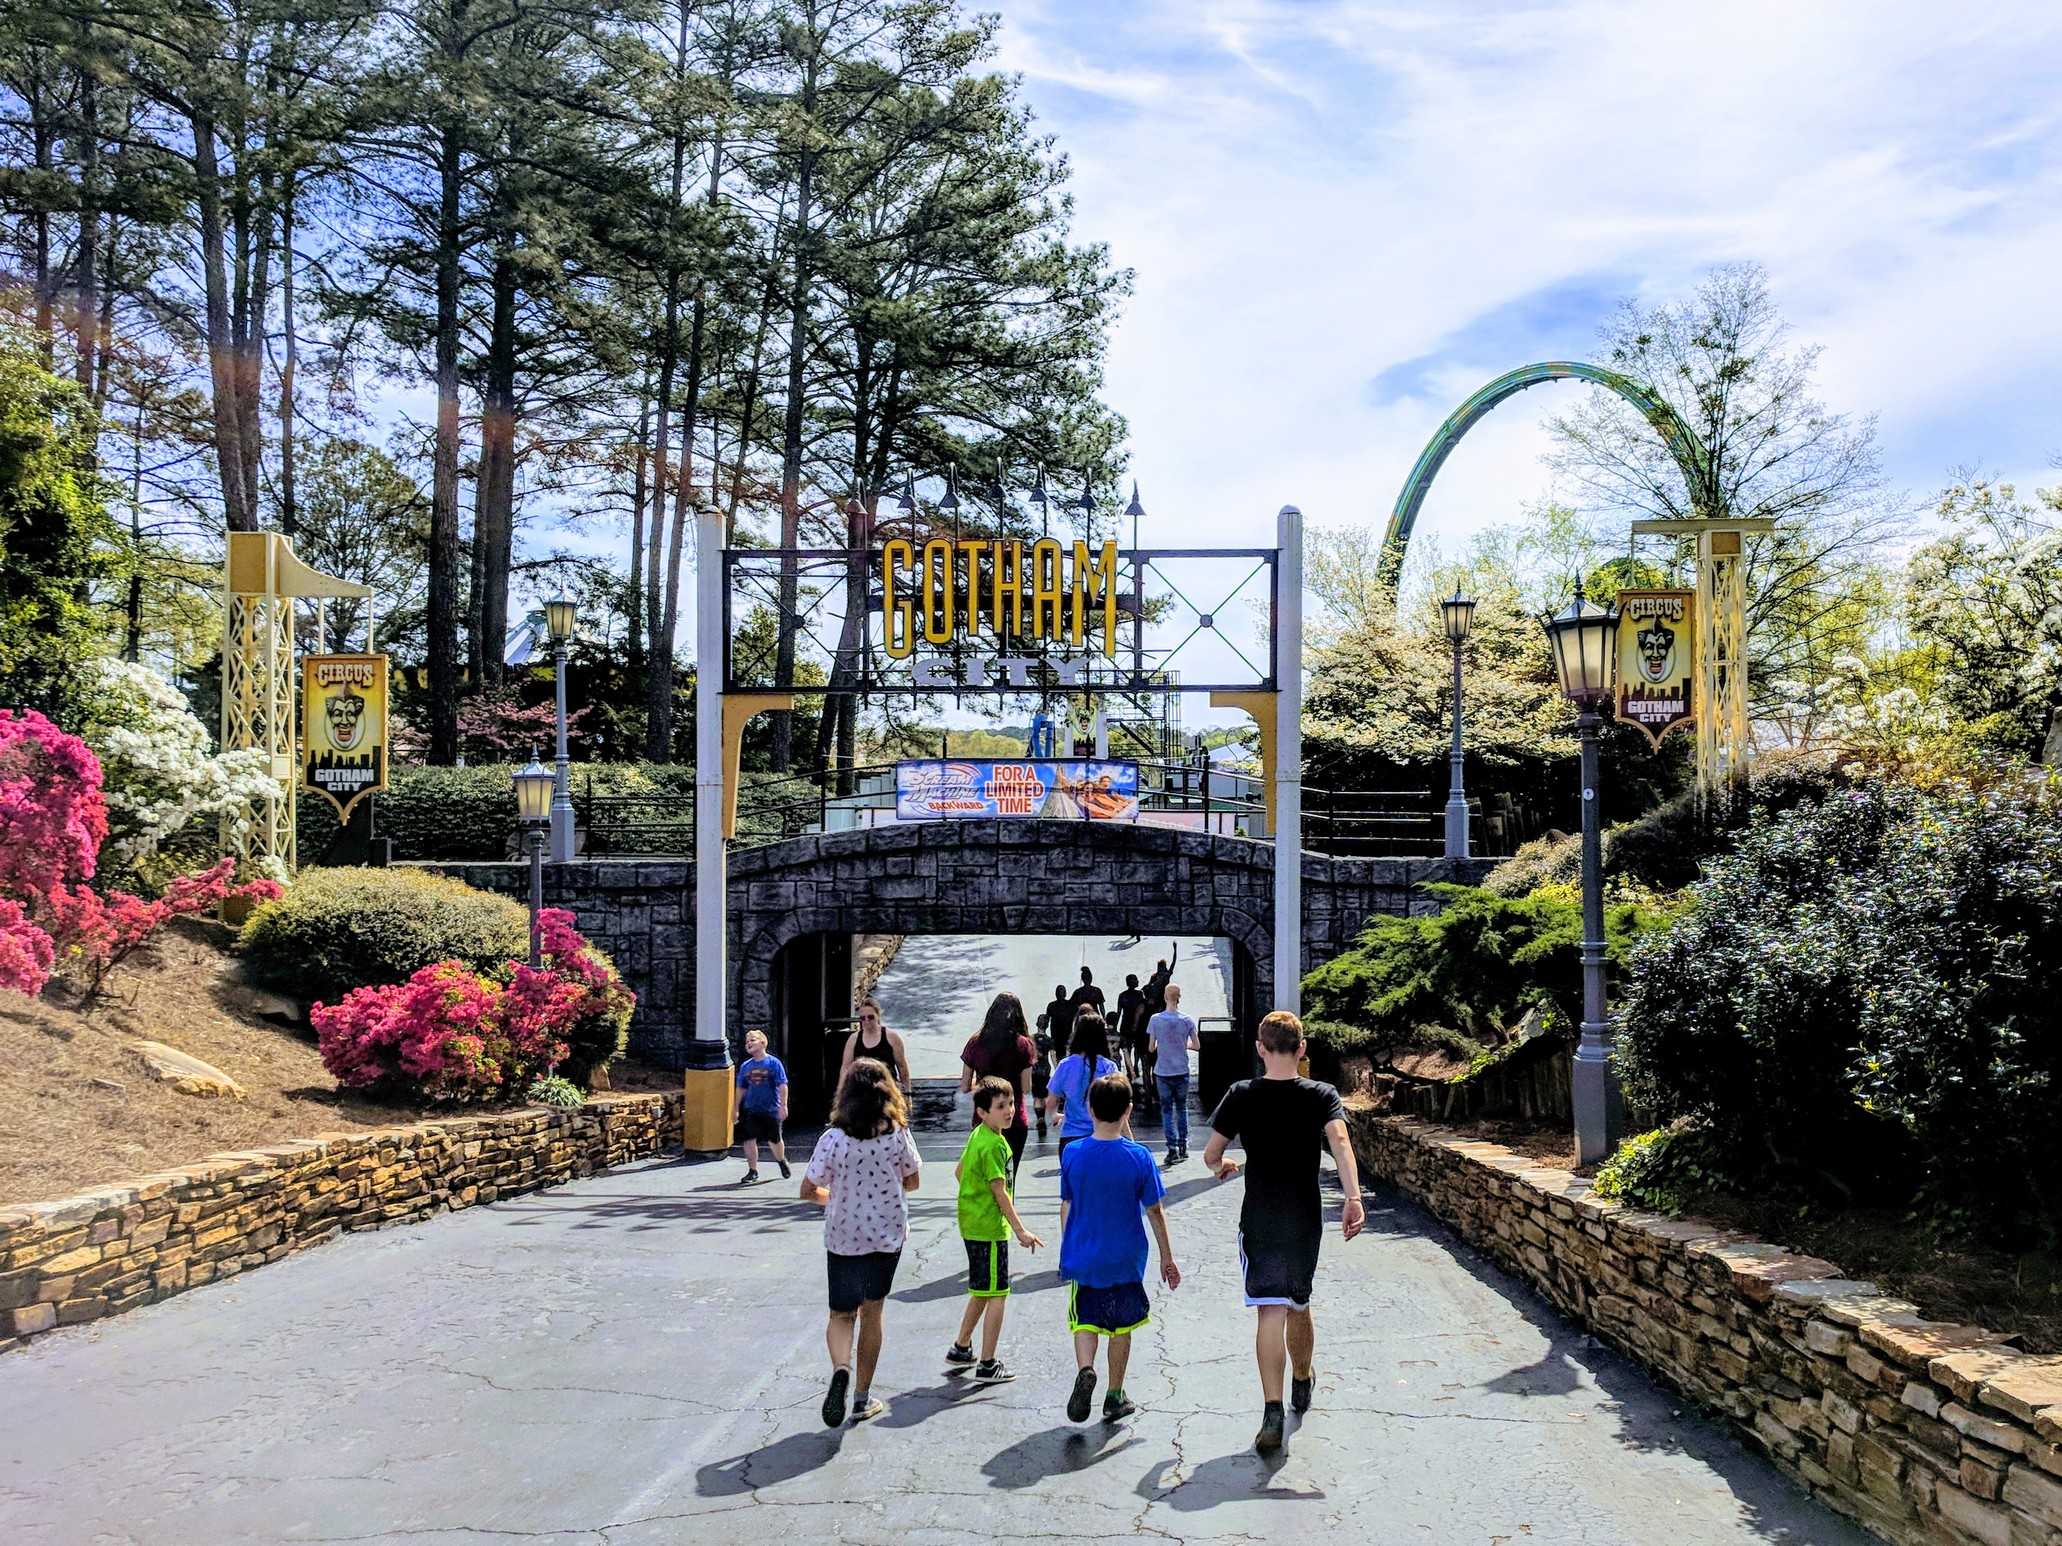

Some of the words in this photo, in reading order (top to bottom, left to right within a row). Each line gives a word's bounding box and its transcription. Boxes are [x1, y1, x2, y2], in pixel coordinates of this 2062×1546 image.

[883, 538, 1117, 659] GOTHAM
[1630, 598, 1683, 621] CIRCUS
[318, 663, 373, 688] CIRCUS
[911, 658, 1089, 686] CITY
[1628, 700, 1684, 713] GOTHAM
[1639, 713, 1673, 723] CITY
[315, 768, 374, 782] GOTHAM
[908, 770, 973, 786] SCREAM
[994, 767, 1023, 782] FOR
[1023, 767, 1036, 782] A
[327, 782, 362, 792] CITY
[903, 785, 979, 803] MACHINE
[985, 782, 1044, 798] LIMITED
[928, 800, 984, 811] BACKWARD
[997, 798, 1032, 813] TIME
